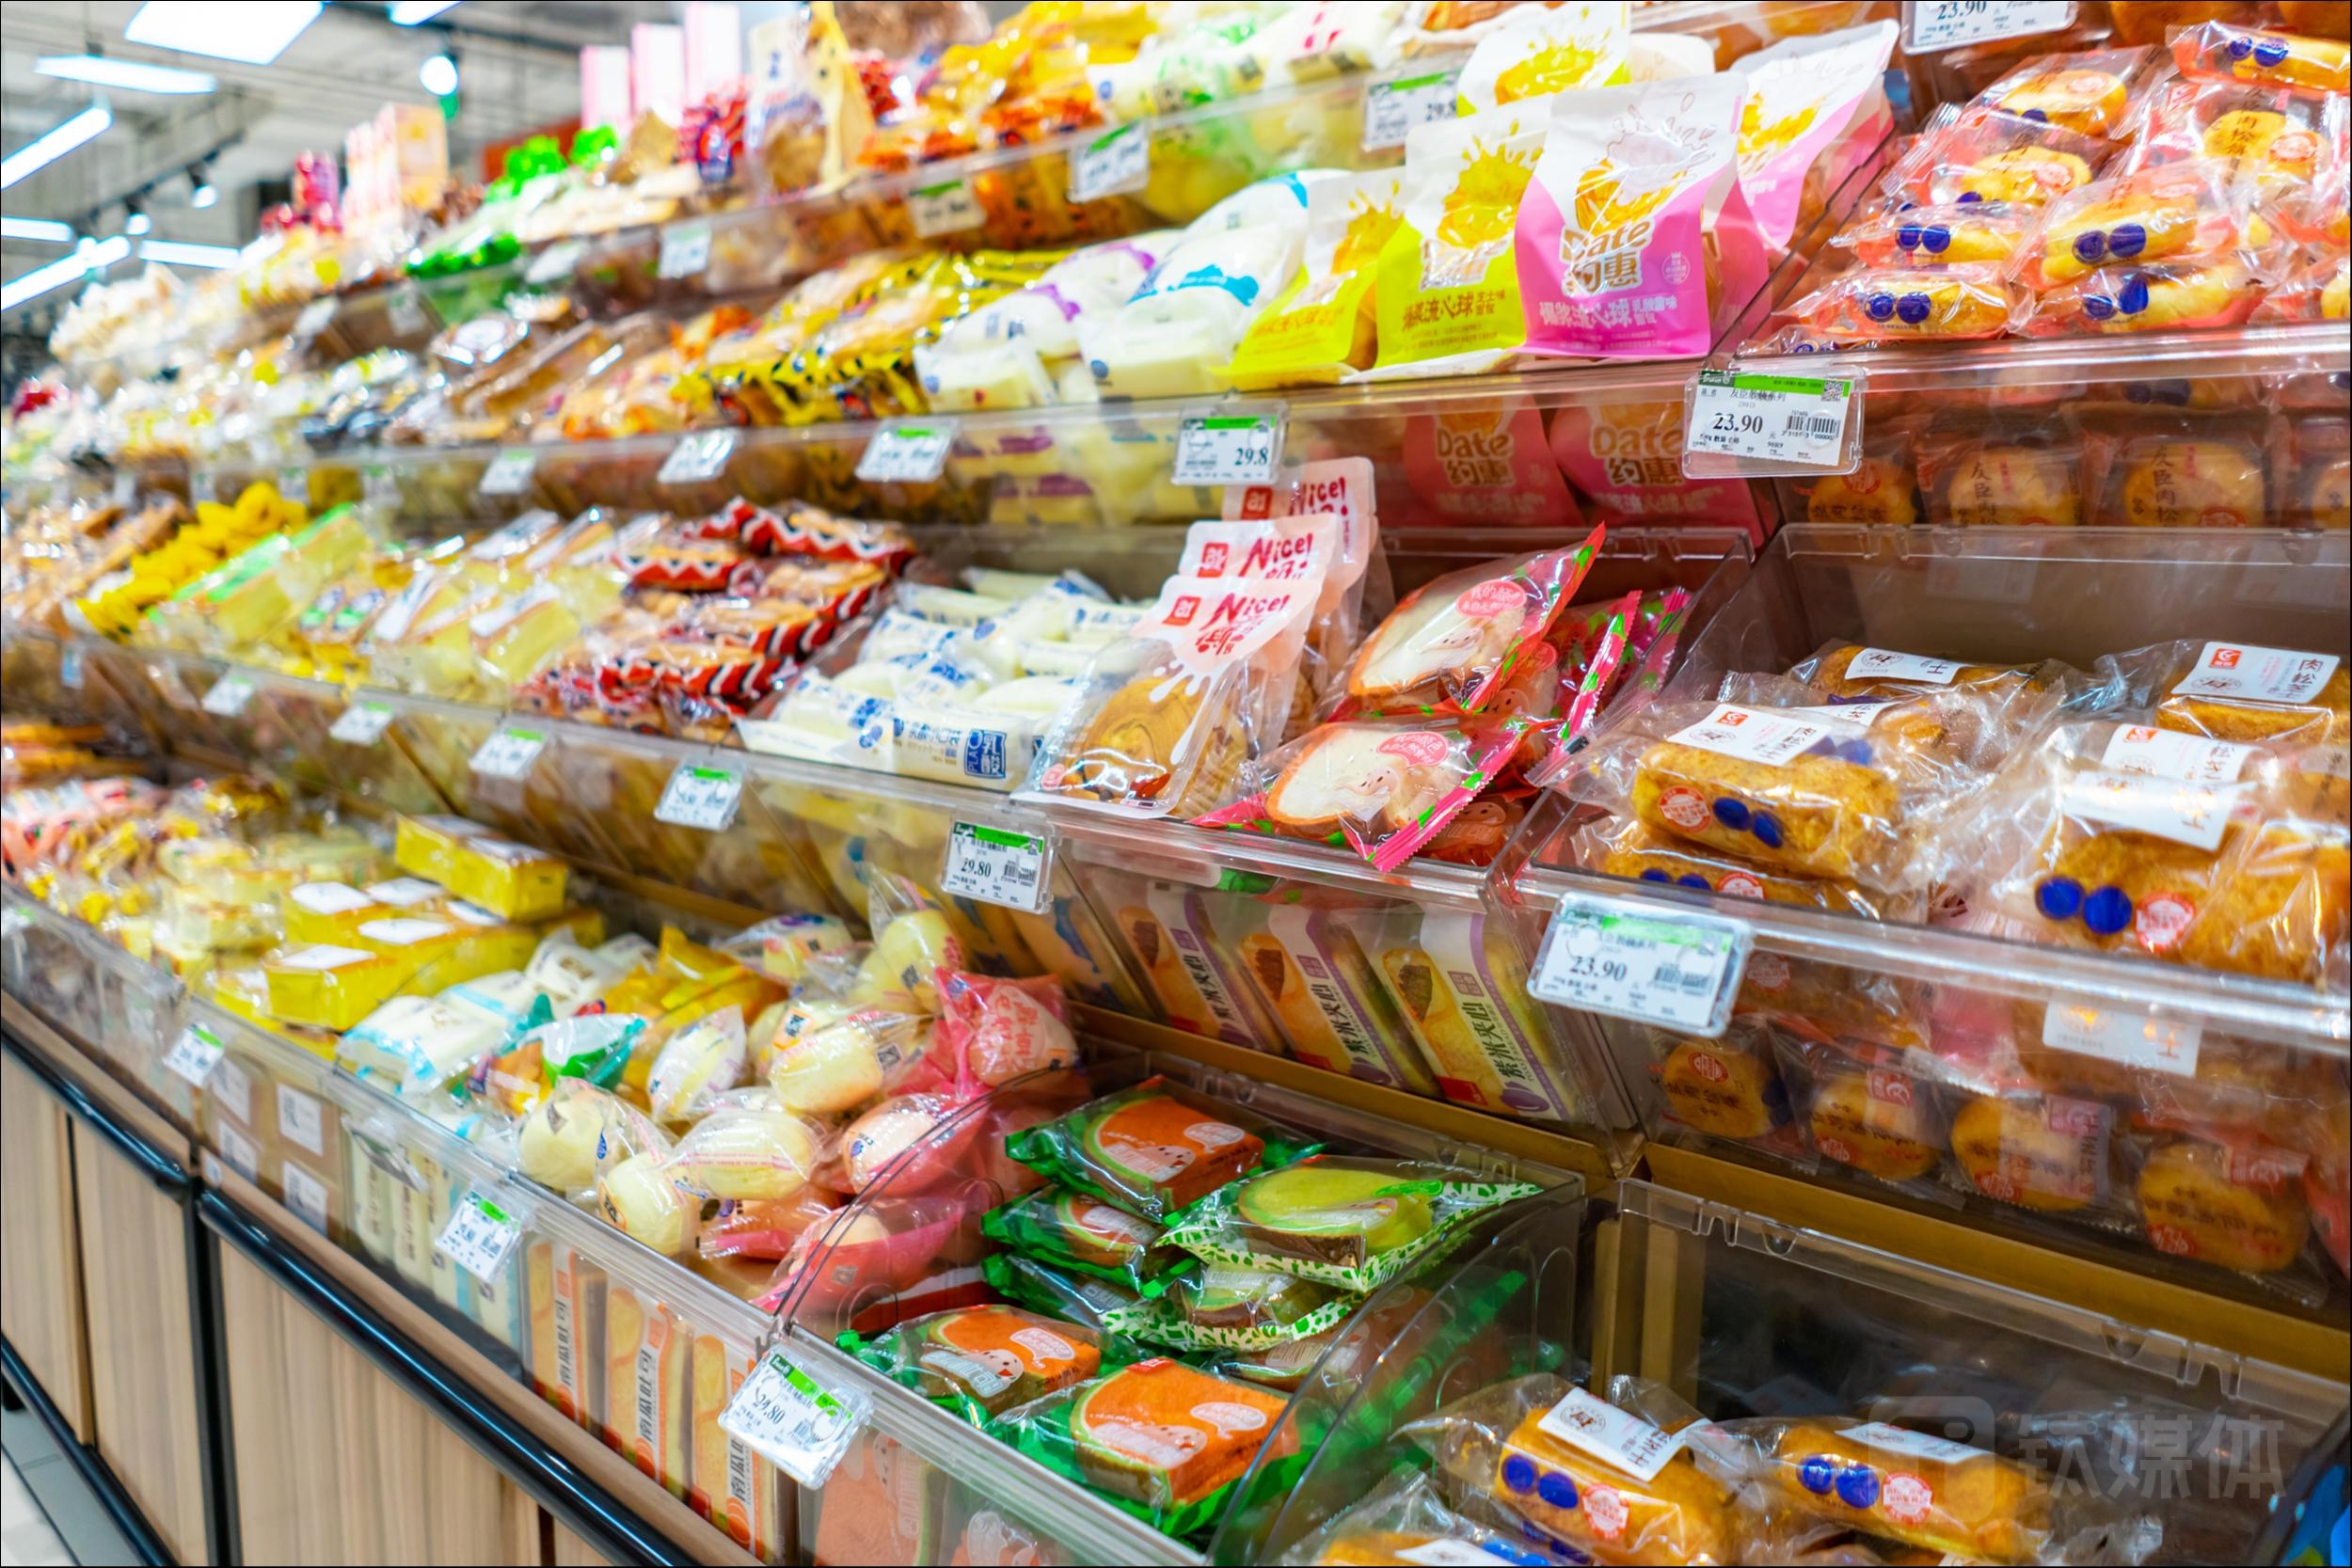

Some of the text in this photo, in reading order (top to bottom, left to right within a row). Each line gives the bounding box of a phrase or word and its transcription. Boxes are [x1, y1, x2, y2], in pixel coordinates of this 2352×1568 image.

[1936, 1, 1987, 21] 23.90
[1562, 219, 1653, 262] Date
[1712, 411, 1764, 435] 23.90
[1233, 446, 1270, 467] 29.8
[1436, 428, 1511, 458] Date
[1592, 426, 1684, 458] Date
[1199, 592, 1291, 631] Nice!
[960, 857, 993, 879] 29.80
[1568, 954, 1628, 982] 23.90
[1460, 1001, 1526, 1081] 紫米夹心
